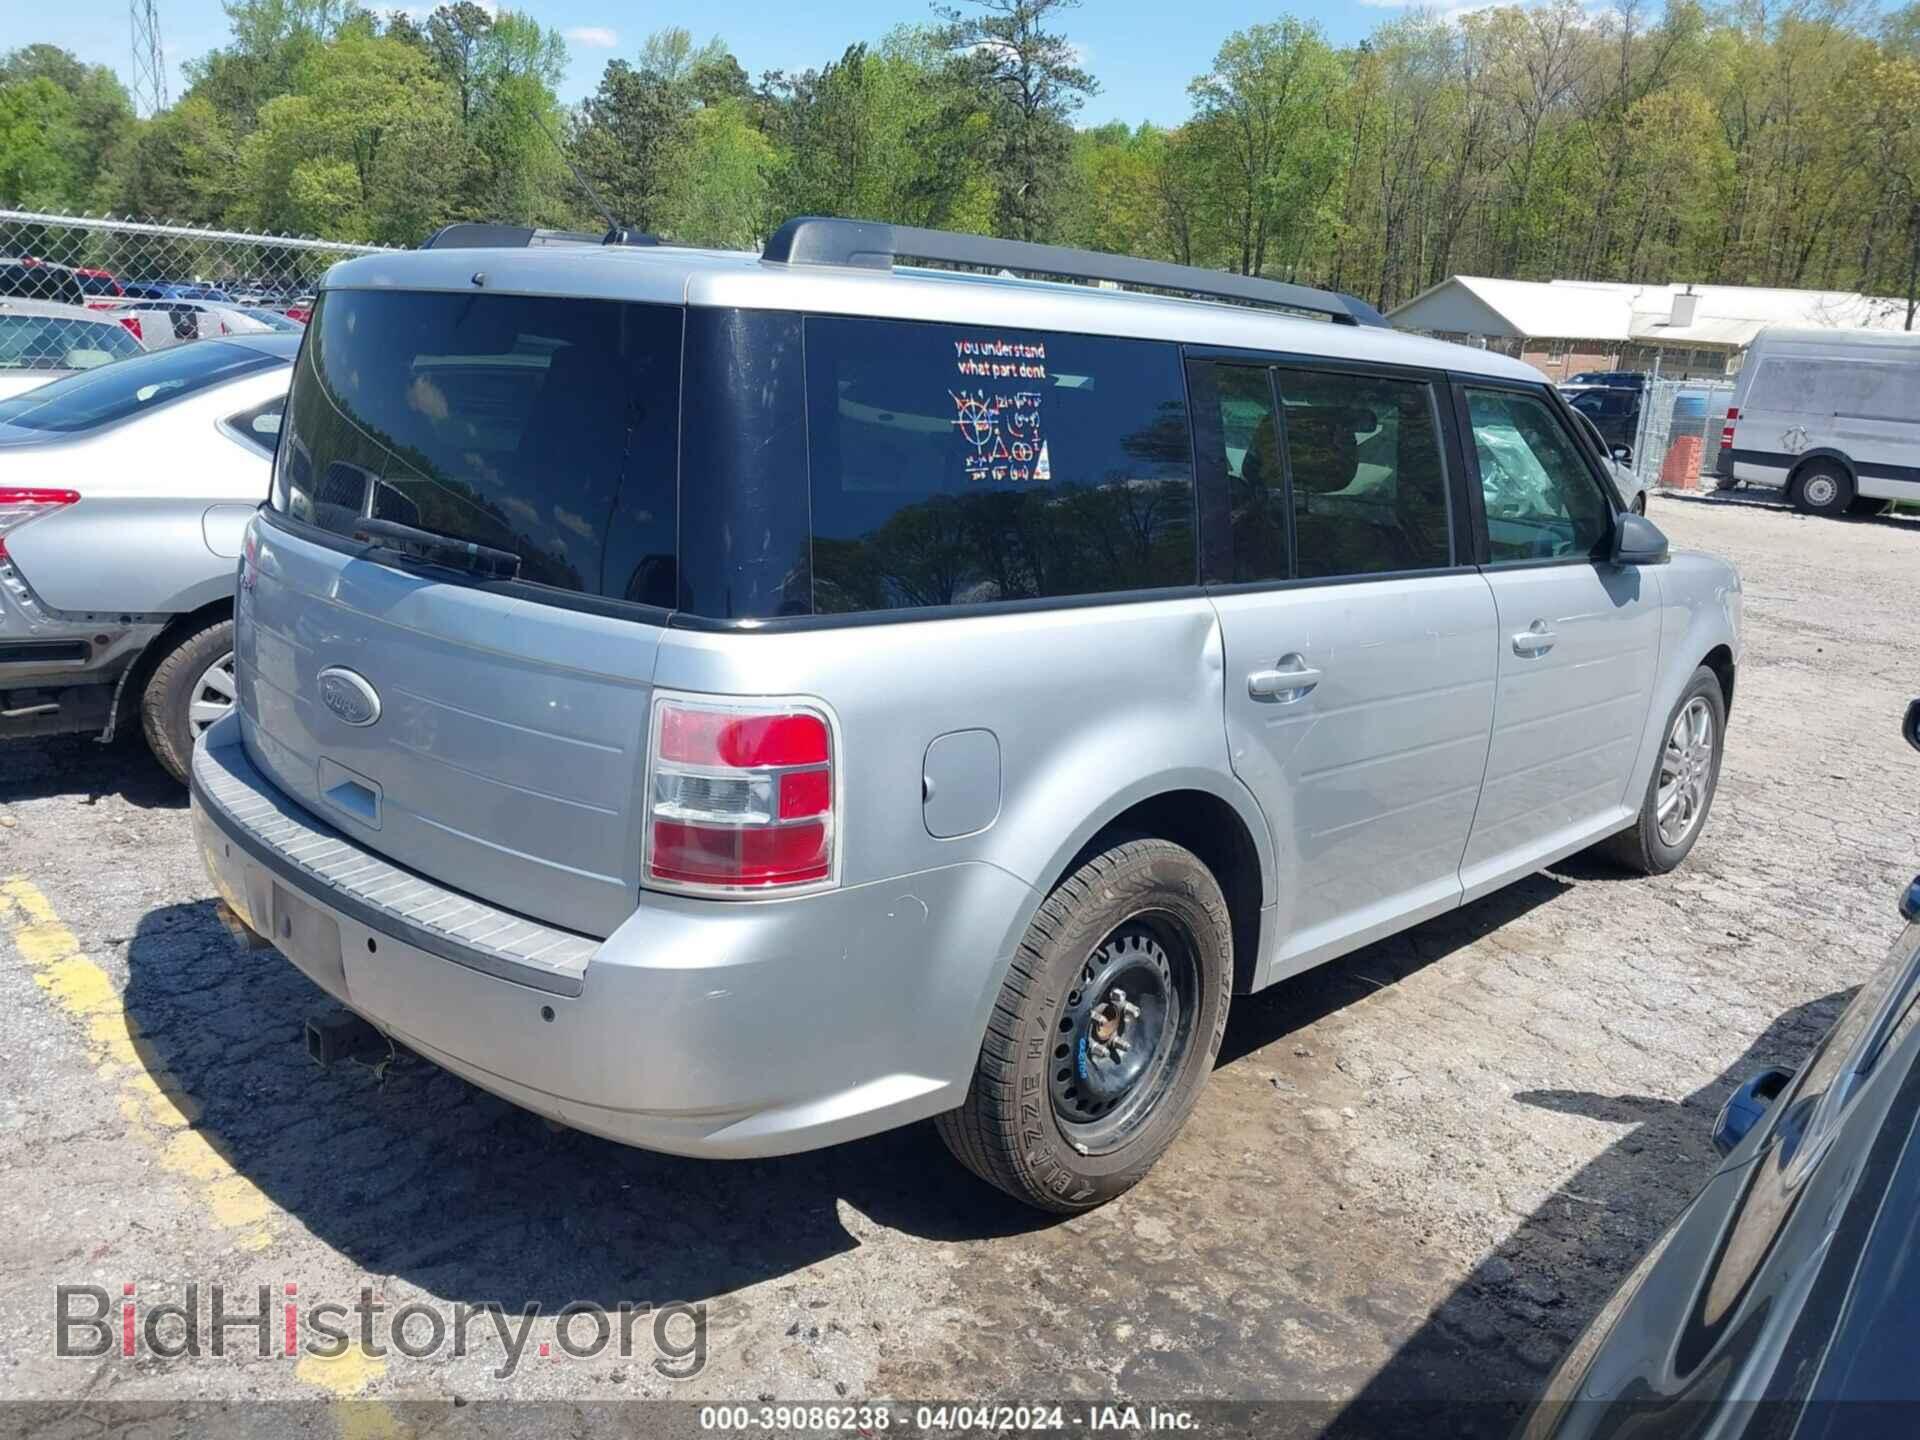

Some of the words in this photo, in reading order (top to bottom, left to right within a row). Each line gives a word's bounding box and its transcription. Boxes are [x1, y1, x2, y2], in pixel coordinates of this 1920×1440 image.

[954, 340, 979, 356] you
[980, 340, 1046, 358] understand
[957, 358, 991, 376] what
[992, 362, 1017, 379] part
[1019, 364, 1046, 378] dont
